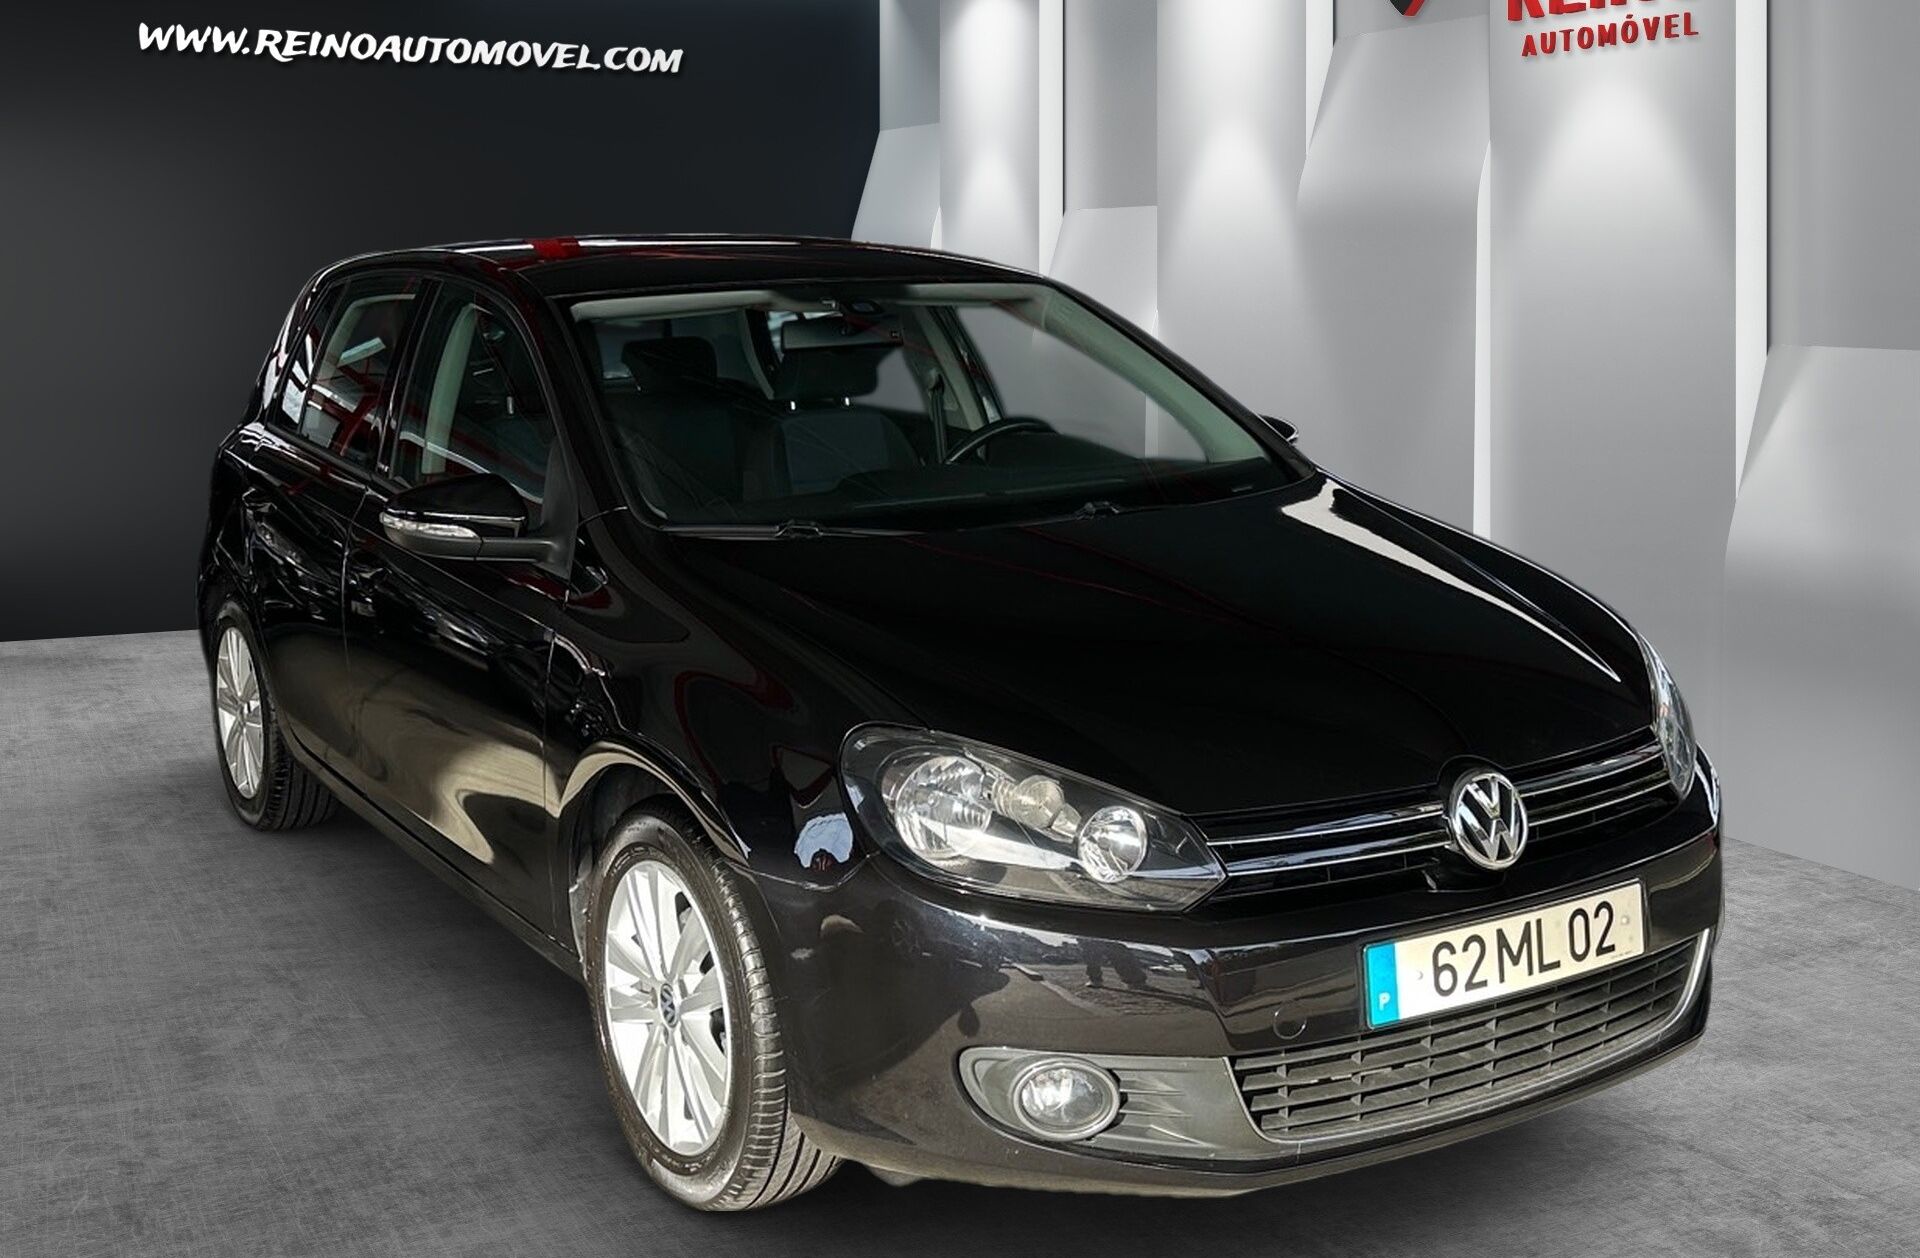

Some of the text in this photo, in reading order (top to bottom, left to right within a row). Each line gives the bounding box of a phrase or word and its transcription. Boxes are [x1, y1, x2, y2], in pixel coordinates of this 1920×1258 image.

[138, 22, 684, 73] WWW.REINOAUTOMOVEL.COM
[1521, 12, 1699, 57] AUTOMÓVEL
[1378, 991, 1391, 1012] P
